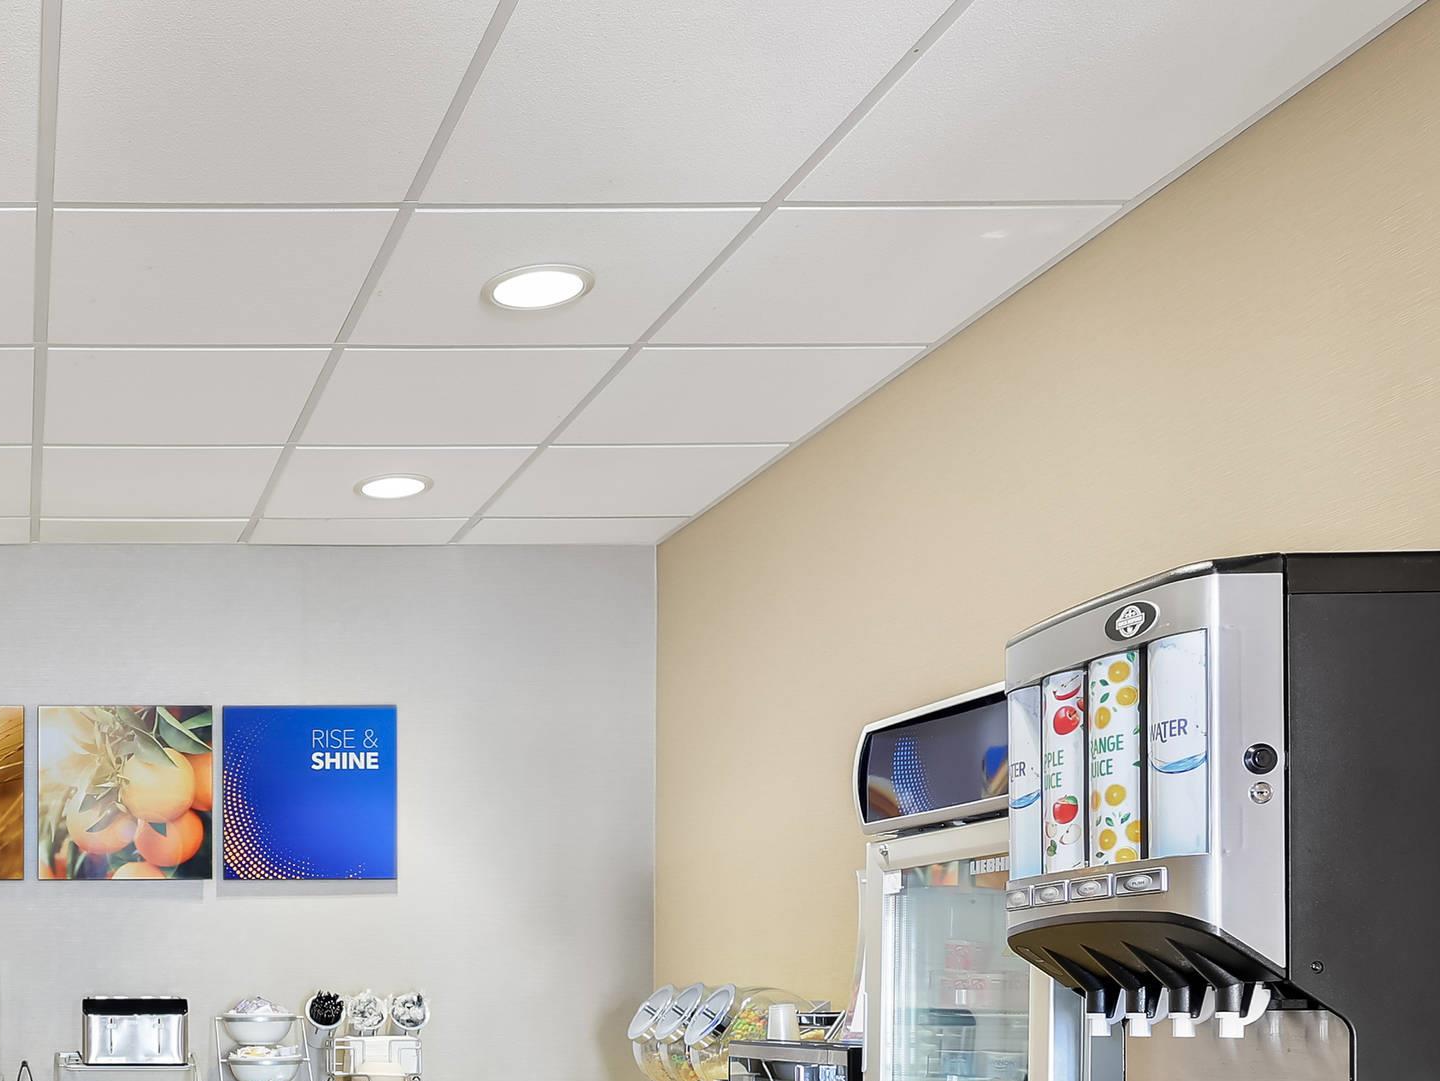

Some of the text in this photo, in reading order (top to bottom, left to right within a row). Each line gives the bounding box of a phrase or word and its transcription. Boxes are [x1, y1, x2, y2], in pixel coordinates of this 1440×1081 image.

[312, 729, 378, 748] RISE &
[311, 751, 379, 770] SHINE
[1091, 758, 1113, 778] UICE
